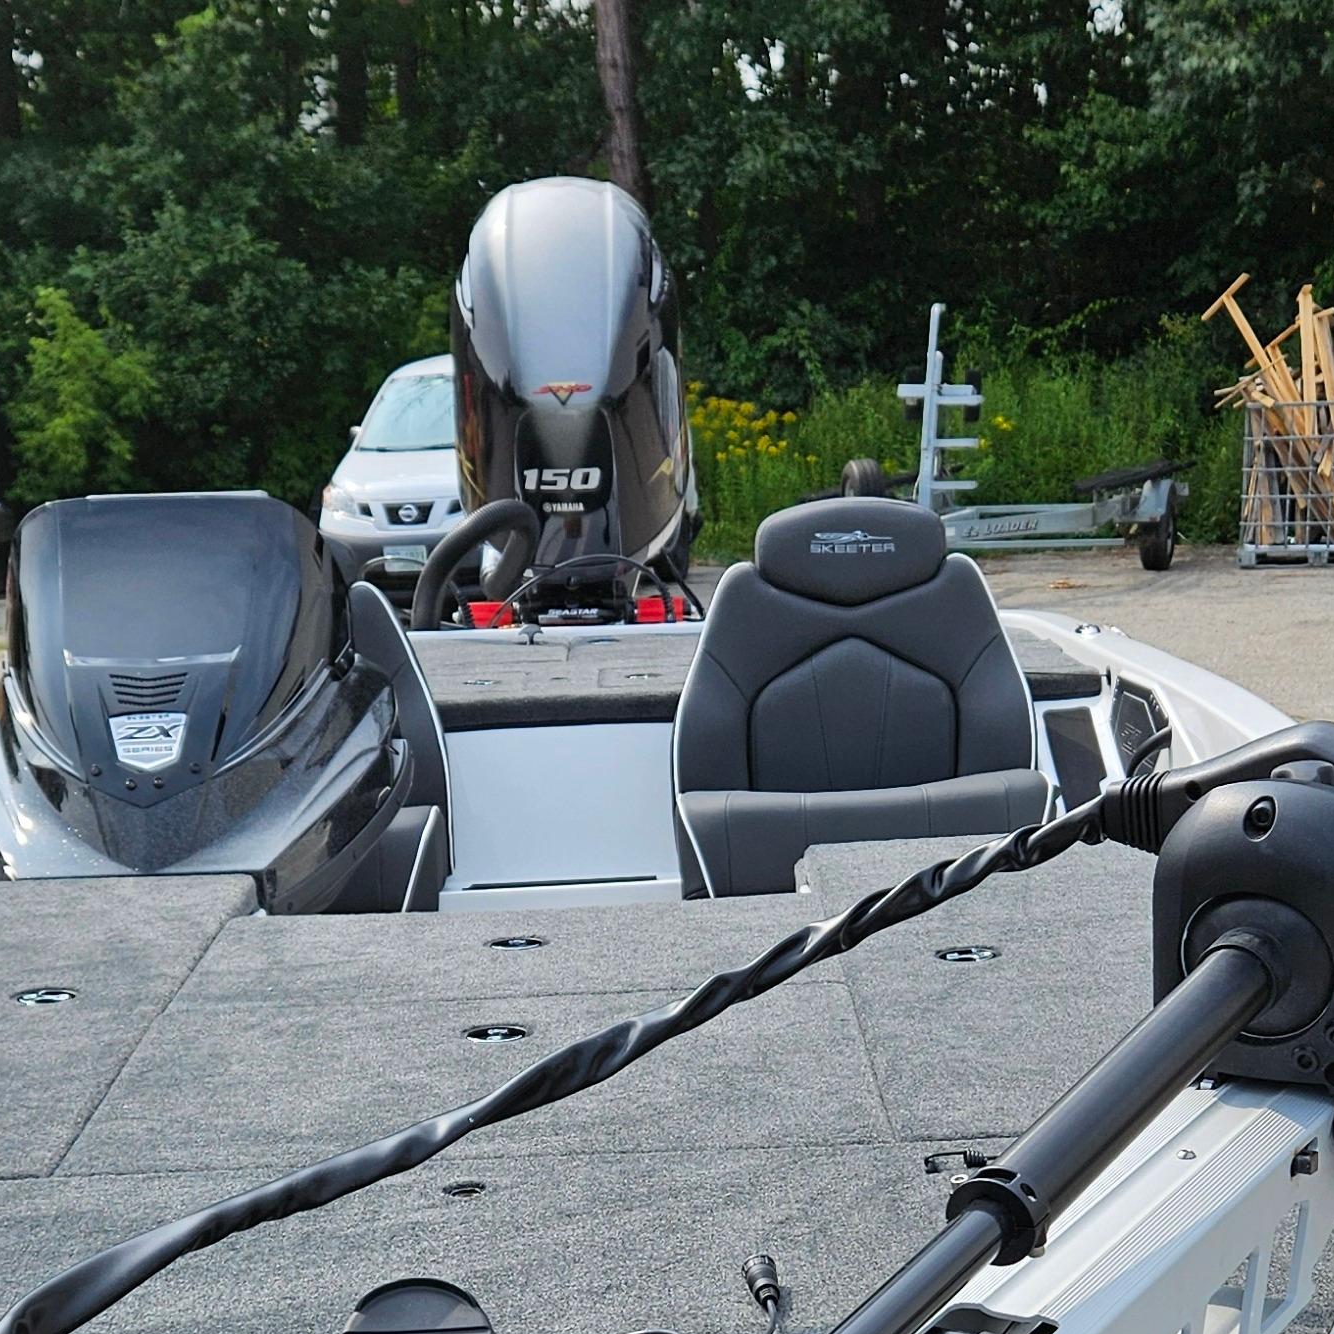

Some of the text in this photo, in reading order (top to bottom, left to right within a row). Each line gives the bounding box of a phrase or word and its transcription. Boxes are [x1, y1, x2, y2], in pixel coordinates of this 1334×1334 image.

[523, 467, 601, 490] 150
[552, 502, 585, 512] YAMAHA
[810, 543, 896, 554] SKEETER
[117, 725, 182, 740] ZX
